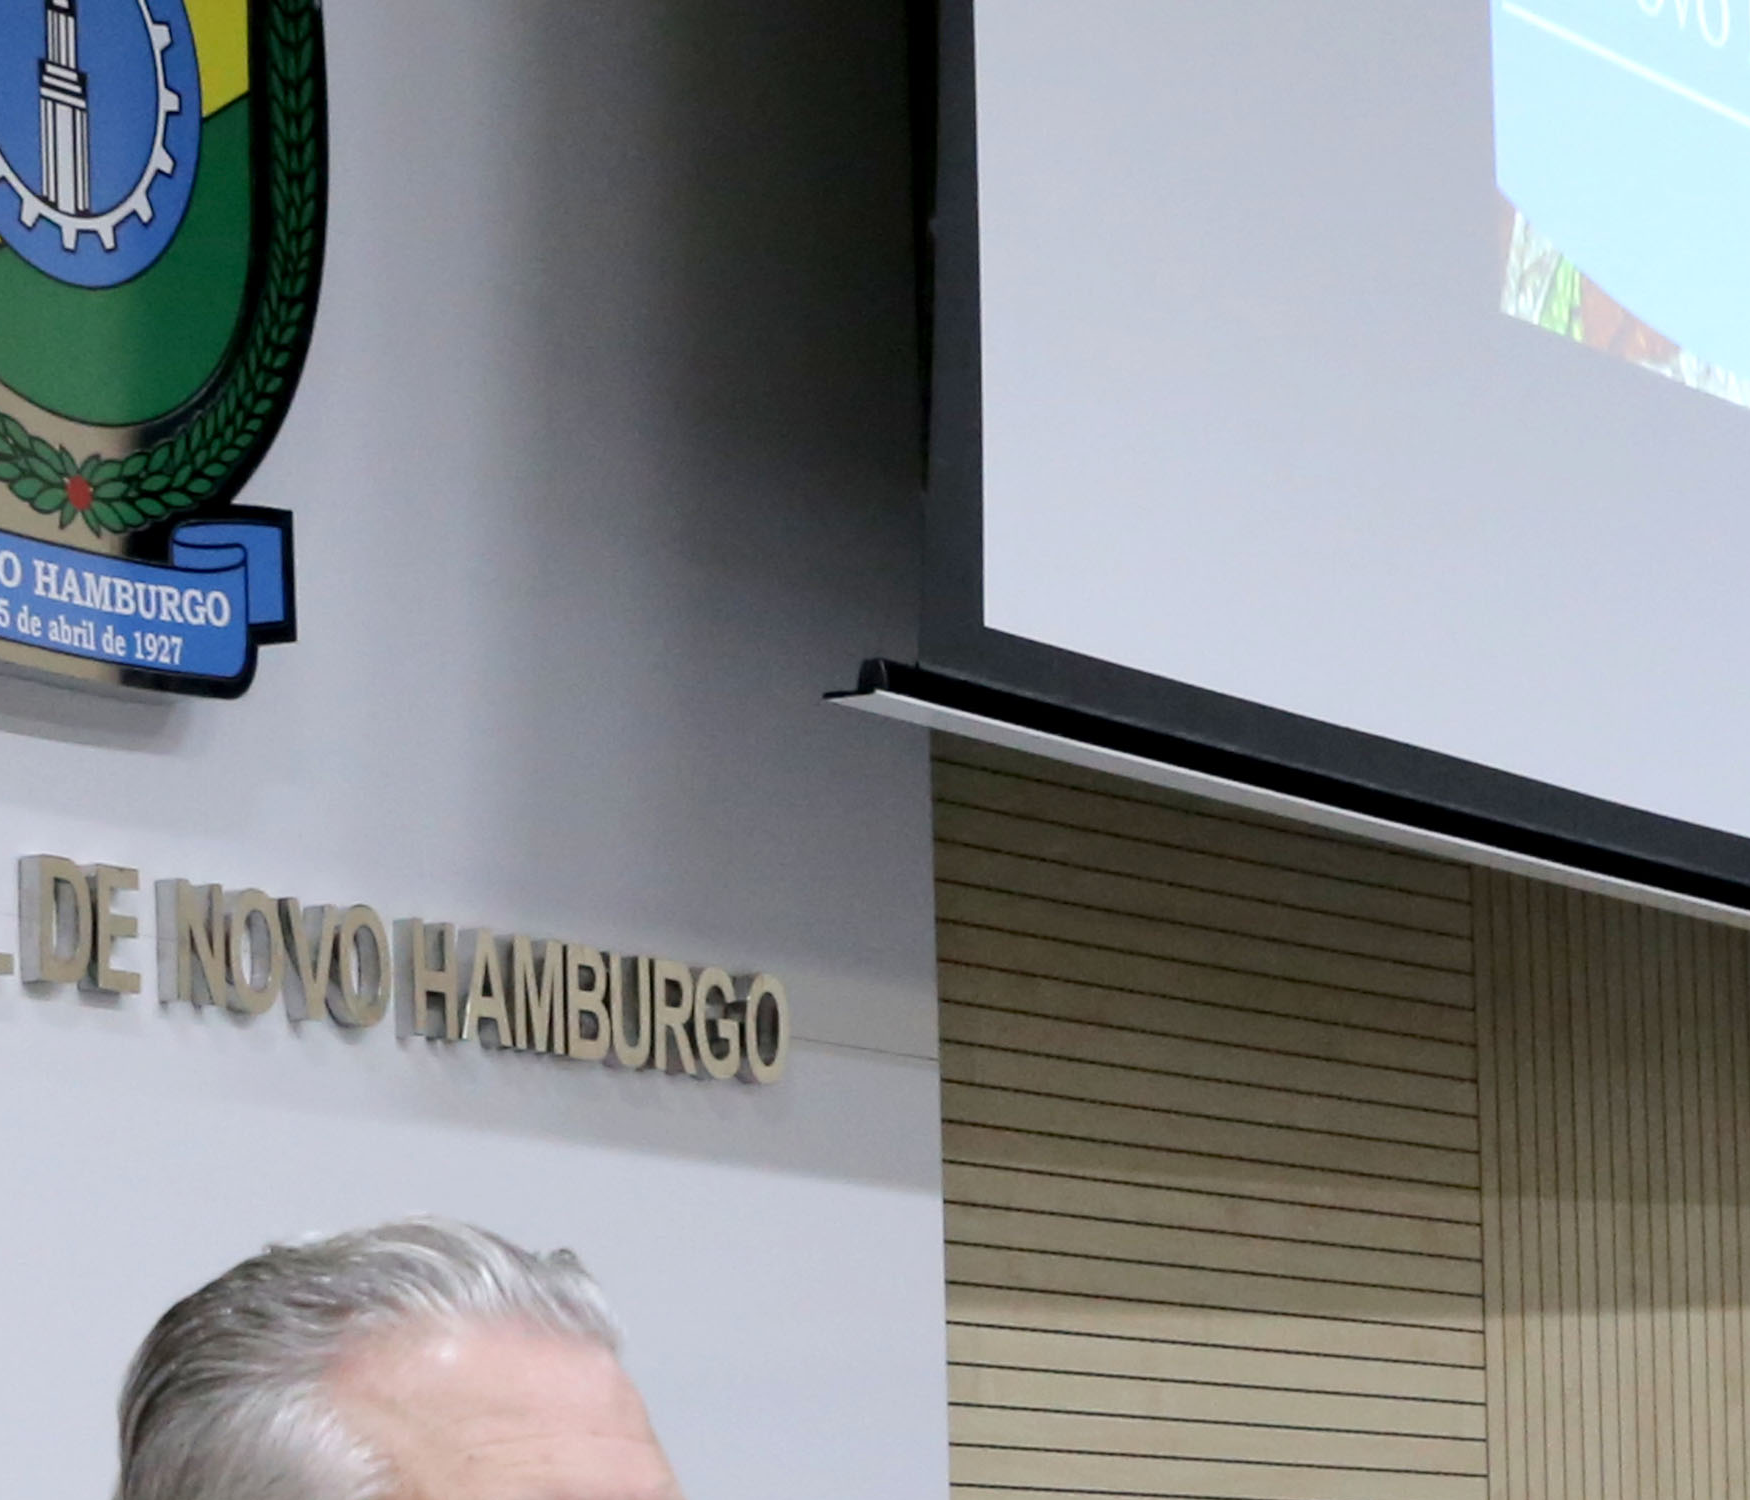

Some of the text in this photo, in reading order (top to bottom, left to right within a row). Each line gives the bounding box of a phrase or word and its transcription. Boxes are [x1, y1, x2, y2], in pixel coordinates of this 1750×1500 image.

[32, 559, 231, 628] HAMBURGO
[17, 606, 42, 637] de
[48, 614, 96, 651] abril
[102, 625, 126, 657] de
[134, 632, 183, 665] 1927
[19, 853, 141, 995] DE
[155, 877, 392, 1029] NOVO
[393, 916, 790, 1085] HAMBURGO
